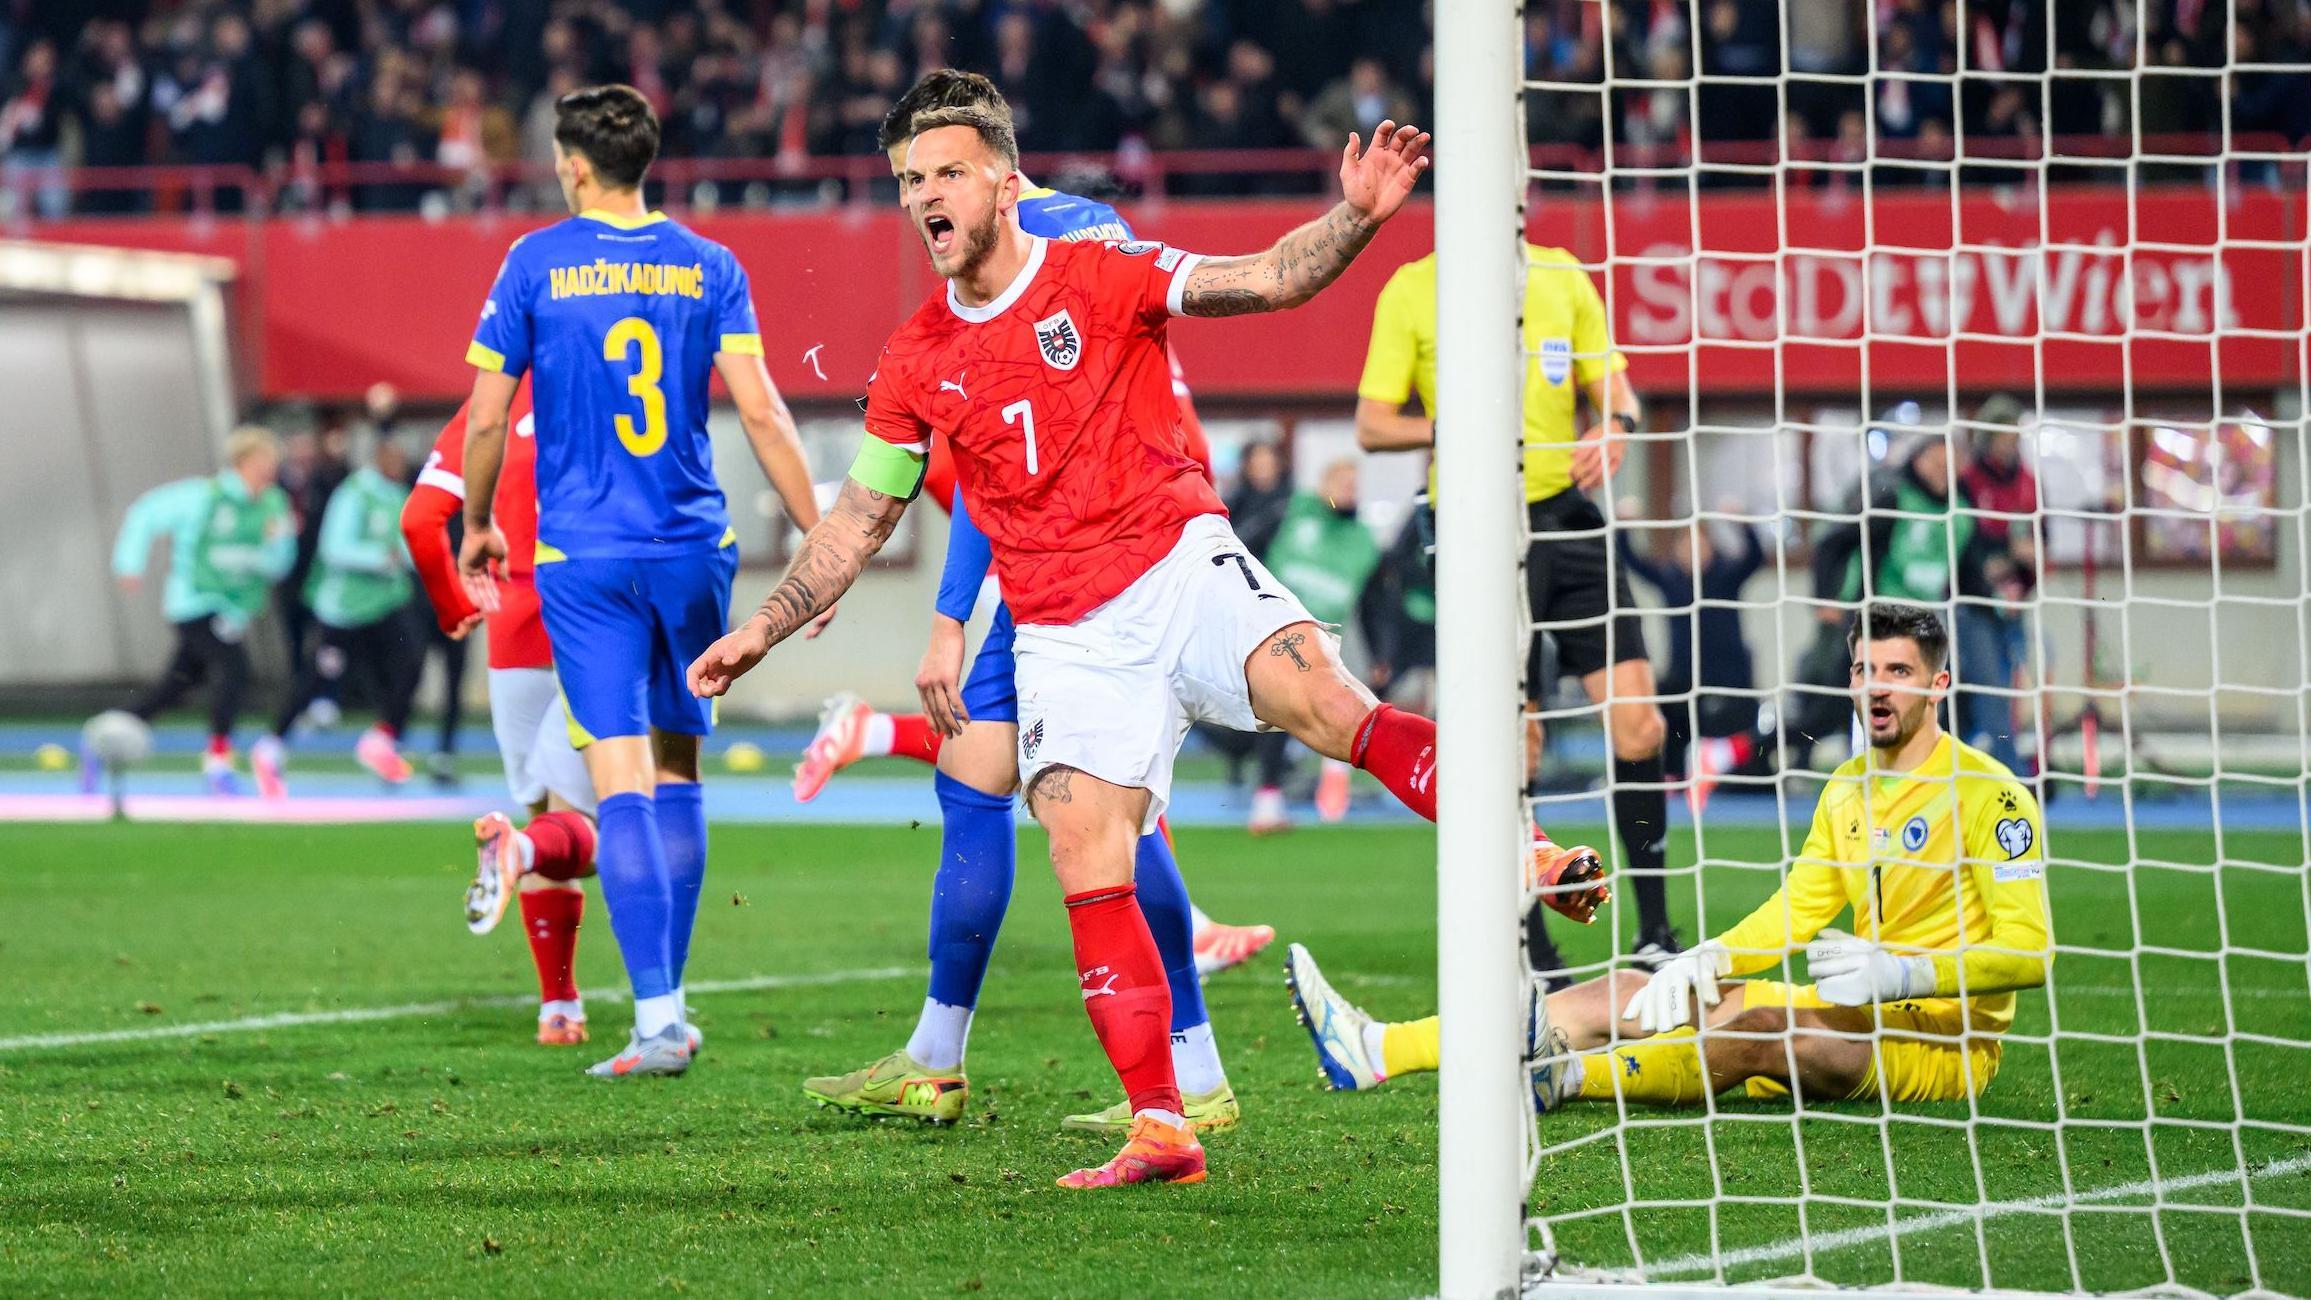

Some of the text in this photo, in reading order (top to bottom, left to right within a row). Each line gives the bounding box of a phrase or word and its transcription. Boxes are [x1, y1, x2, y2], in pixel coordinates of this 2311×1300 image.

[550, 258, 704, 300] HADŽIKADUNIĆ
[1980, 228, 2240, 335] Wien
[603, 316, 668, 457] 3
[1001, 398, 1039, 476] 7
[1211, 552, 1261, 591] 7
[1871, 865, 1884, 924] 1
